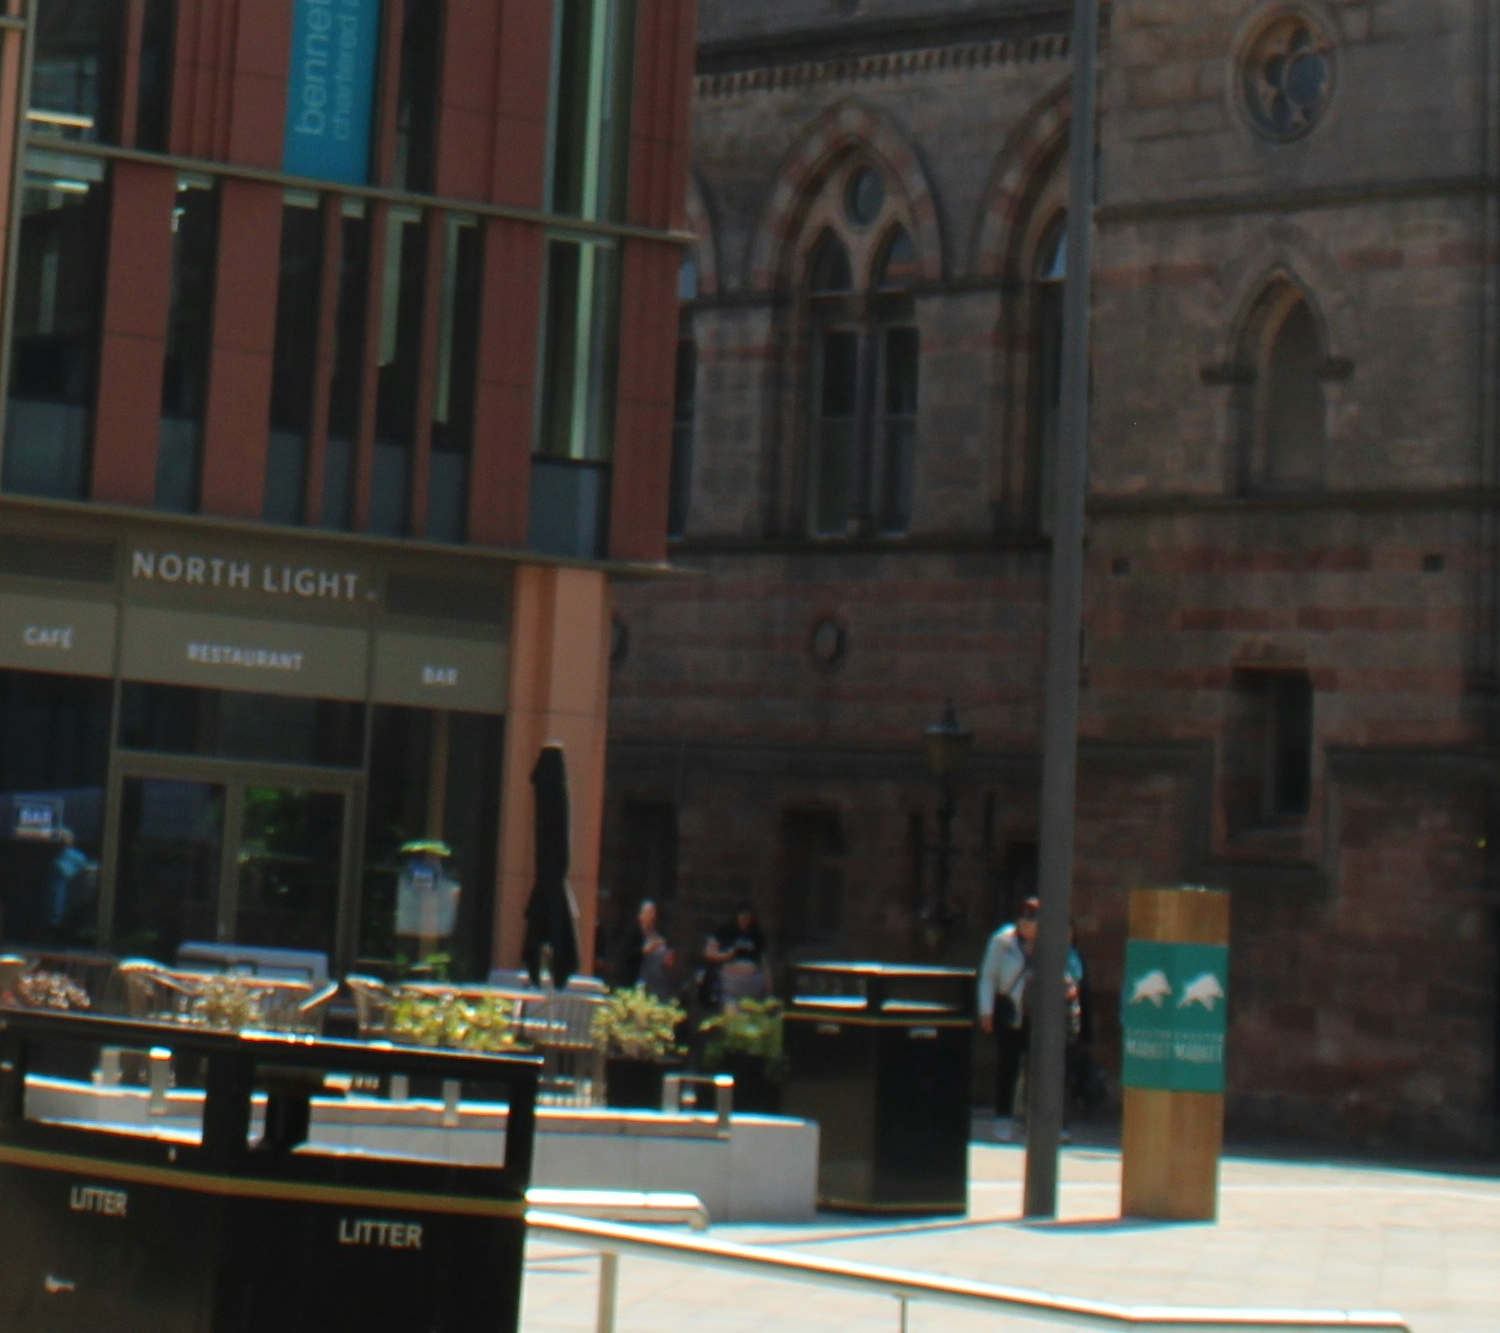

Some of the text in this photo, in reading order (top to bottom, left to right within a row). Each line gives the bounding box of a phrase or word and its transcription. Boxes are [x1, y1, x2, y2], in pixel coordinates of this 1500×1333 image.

[329, 15, 359, 141] chartered
[132, 550, 359, 601] NORTH LIGHT
[24, 626, 74, 650] CAFÉ
[187, 642, 304, 671] RESTAURANT
[422, 665, 457, 686] BAR
[70, 1186, 127, 1217] LITTER
[338, 1219, 422, 1250] LITTER
